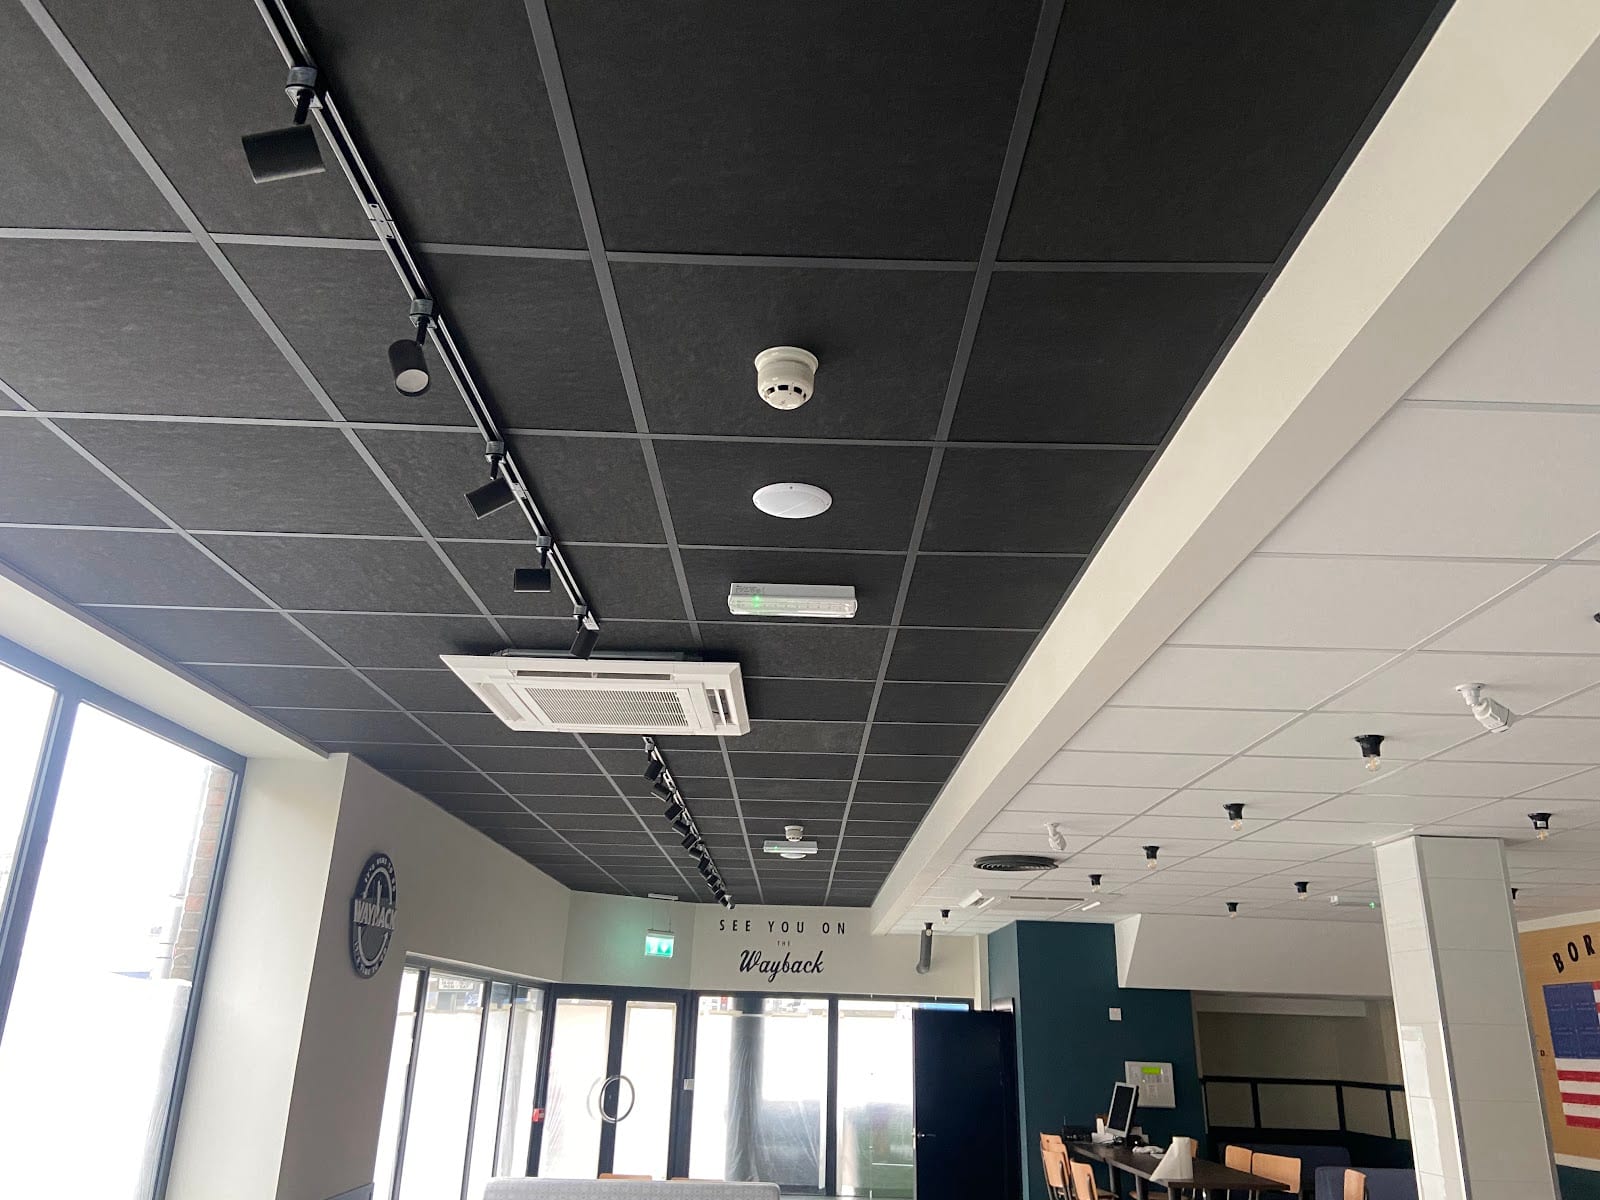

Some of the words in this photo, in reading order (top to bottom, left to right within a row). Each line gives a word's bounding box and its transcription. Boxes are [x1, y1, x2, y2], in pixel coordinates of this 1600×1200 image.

[353, 898, 398, 930] WAYBACK
[719, 919, 751, 932] SEE
[768, 921, 804, 934] YOU
[822, 922, 845, 935] ON
[739, 949, 824, 983] Wayback
